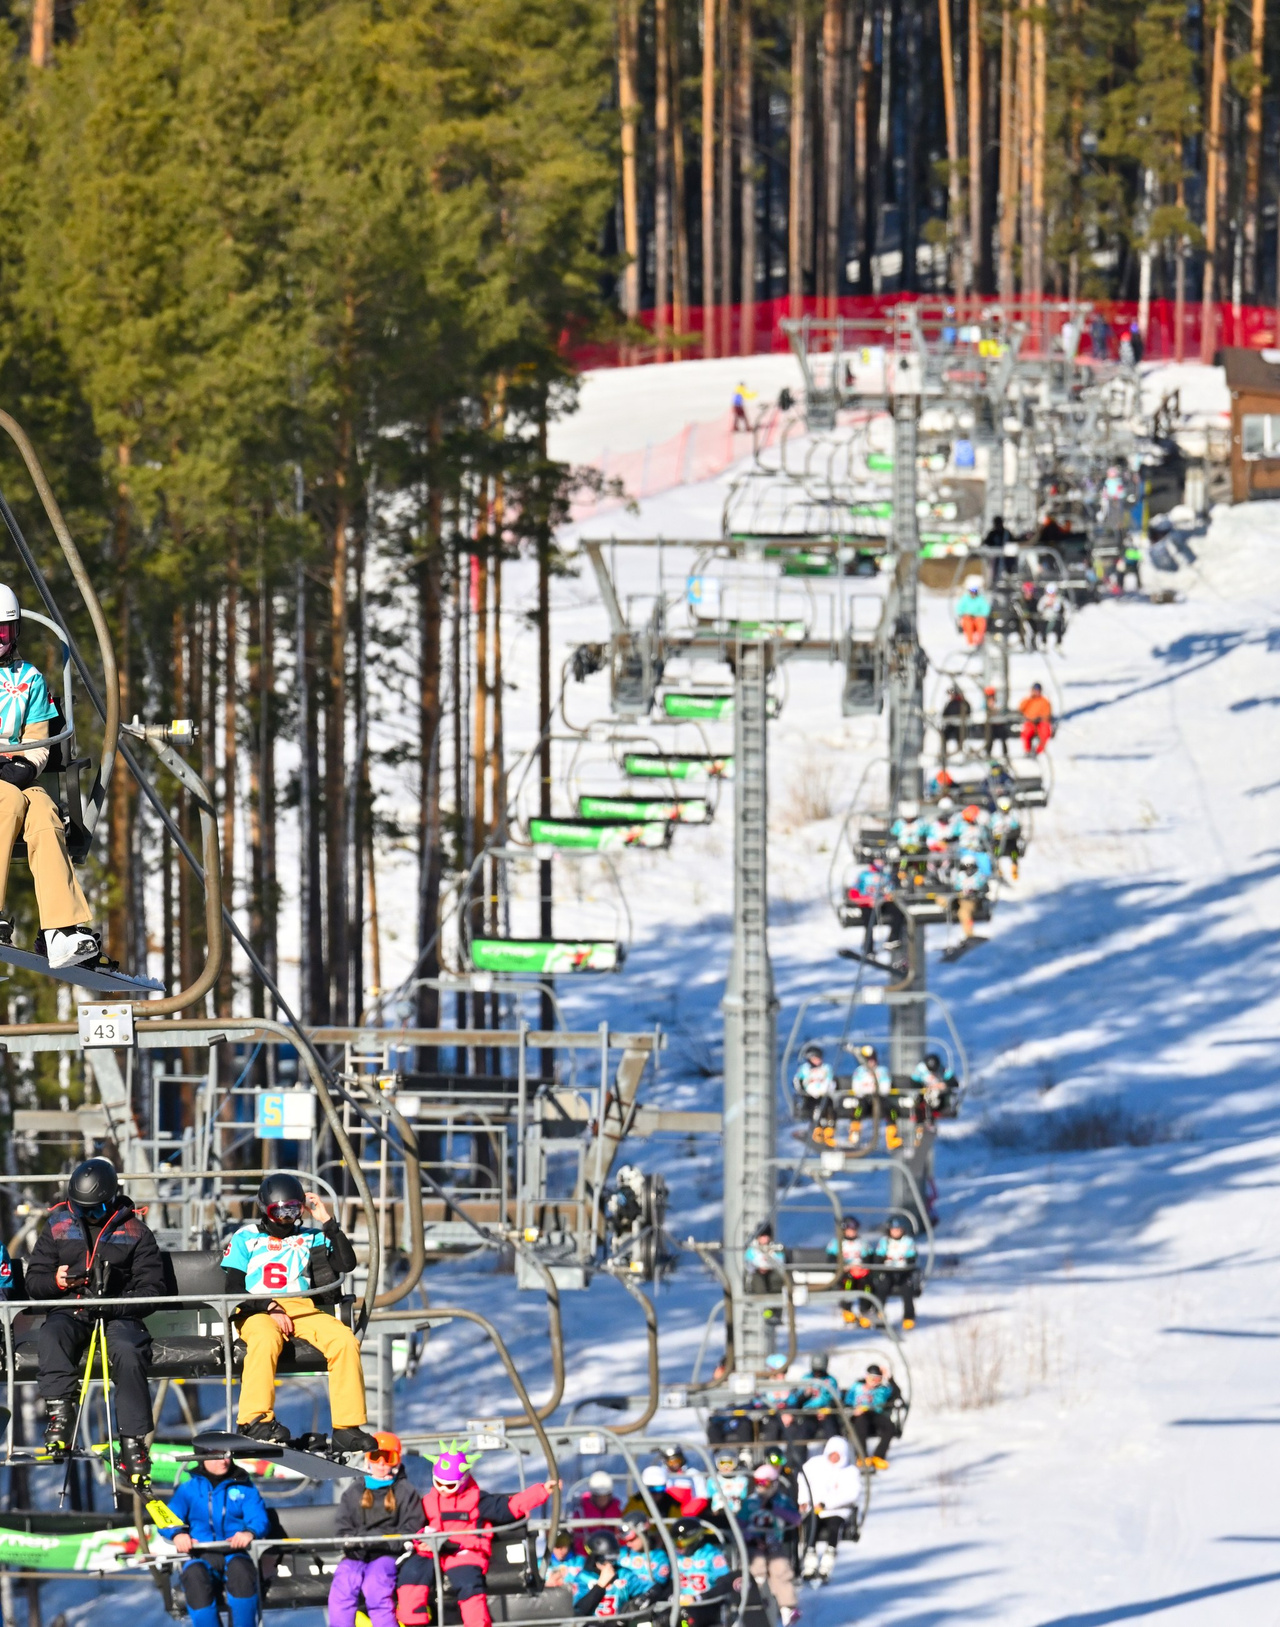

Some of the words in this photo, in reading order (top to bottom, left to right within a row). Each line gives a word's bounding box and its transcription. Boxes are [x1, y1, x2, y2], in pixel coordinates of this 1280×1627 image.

[93, 1024, 115, 1039] 43
[261, 1261, 289, 1290] 6
[153, 1505, 174, 1525] HEAD
